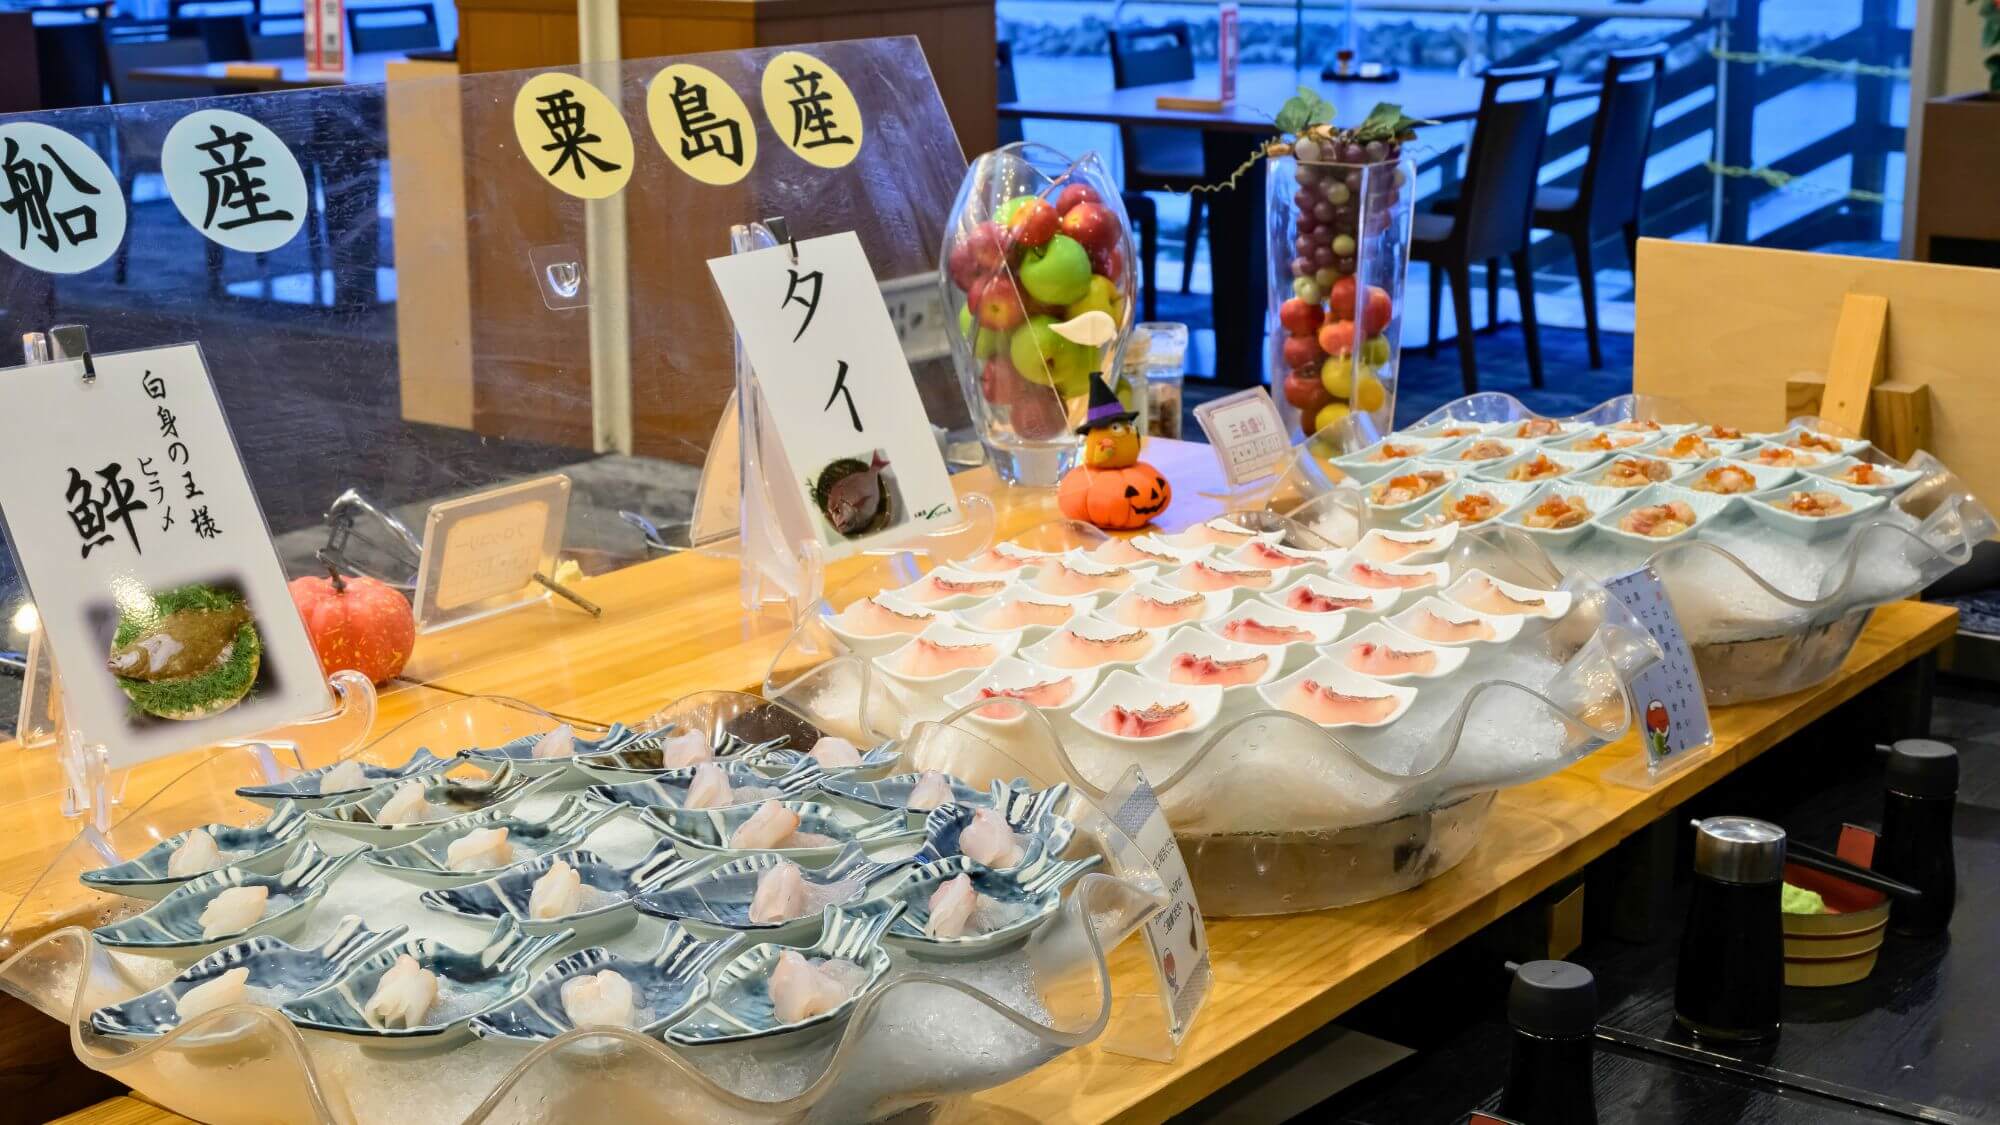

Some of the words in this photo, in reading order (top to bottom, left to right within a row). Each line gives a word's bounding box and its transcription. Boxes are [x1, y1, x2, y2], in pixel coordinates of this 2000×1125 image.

[537, 66, 854, 180] 粟島産
[780, 266, 865, 434] タイ
[65, 460, 148, 560] 鮃
[137, 457, 176, 533] ヒラメ
[142, 369, 223, 541] 白身の王様
